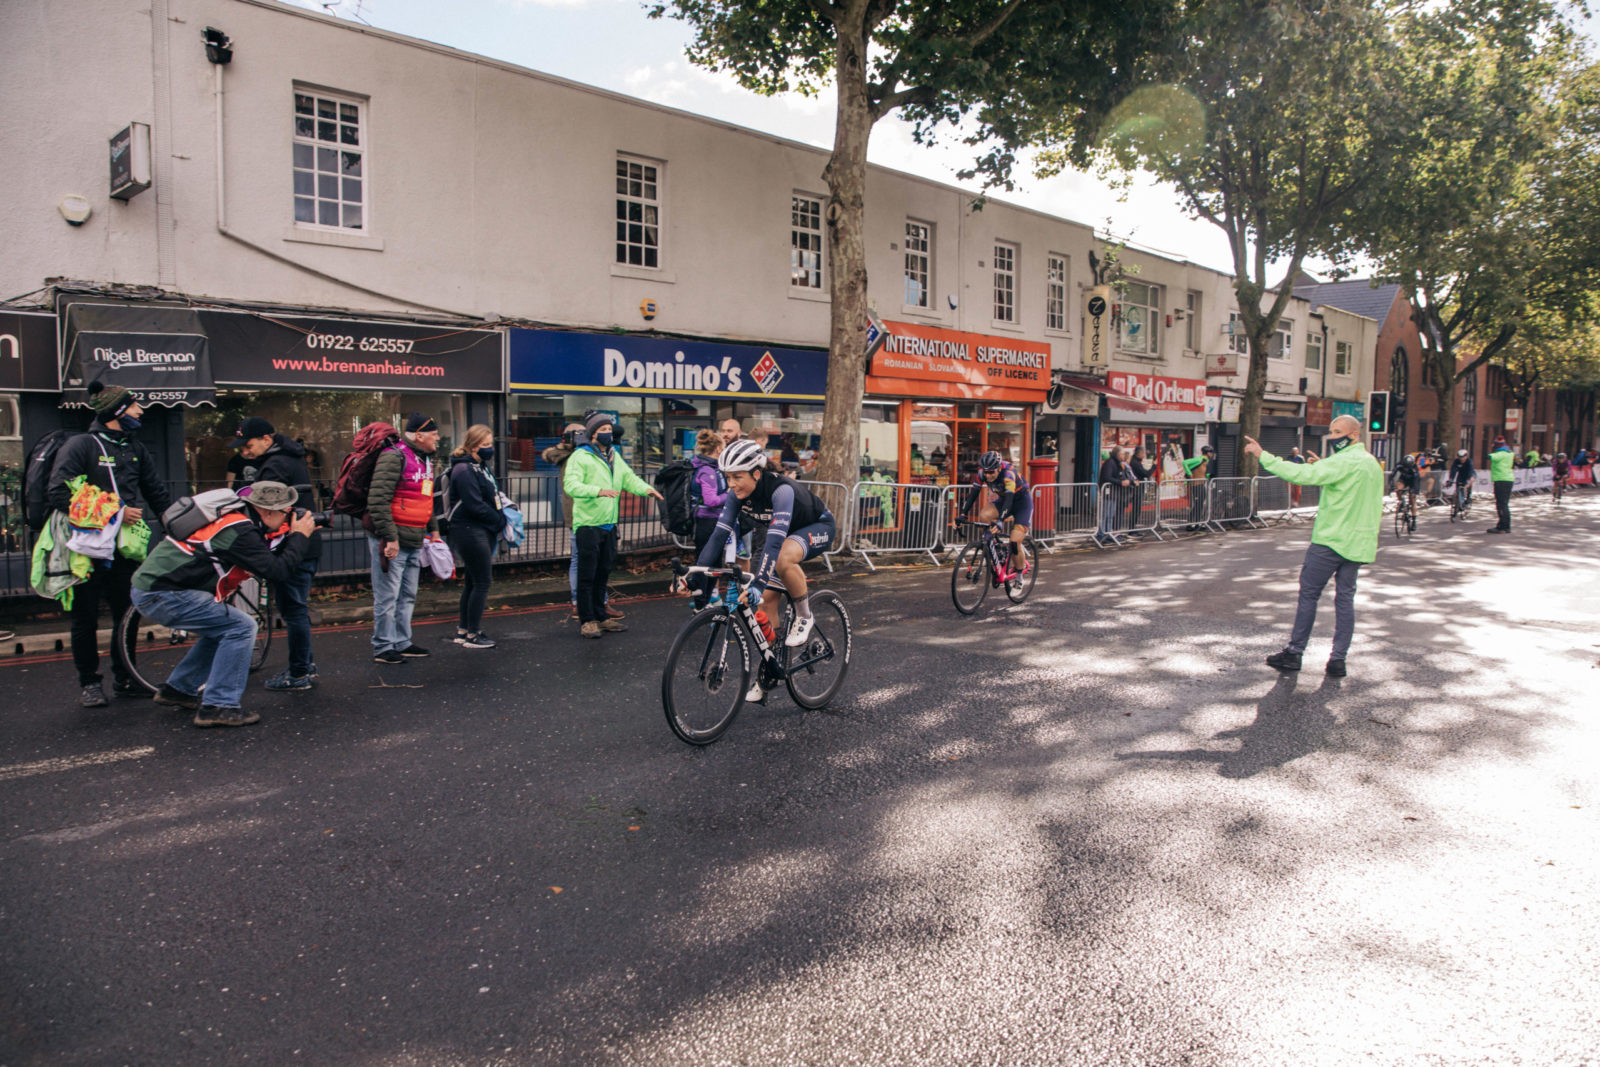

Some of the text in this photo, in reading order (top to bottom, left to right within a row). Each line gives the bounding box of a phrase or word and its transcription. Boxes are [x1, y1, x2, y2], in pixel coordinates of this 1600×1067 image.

[307, 333, 414, 353] 01922 625557
[885, 335, 972, 360] INTERNATIONAL
[976, 346, 1047, 368] SUPERMARKET
[136, 349, 195, 362] Brennan
[884, 358, 923, 370] ROMANIAN
[272, 356, 445, 377] www.brennanhair.com
[604, 348, 742, 392] Domino's
[987, 367, 1038, 381] OFF LICENCE
[148, 391, 187, 400] 625557
[1127, 374, 1153, 401] Pod
